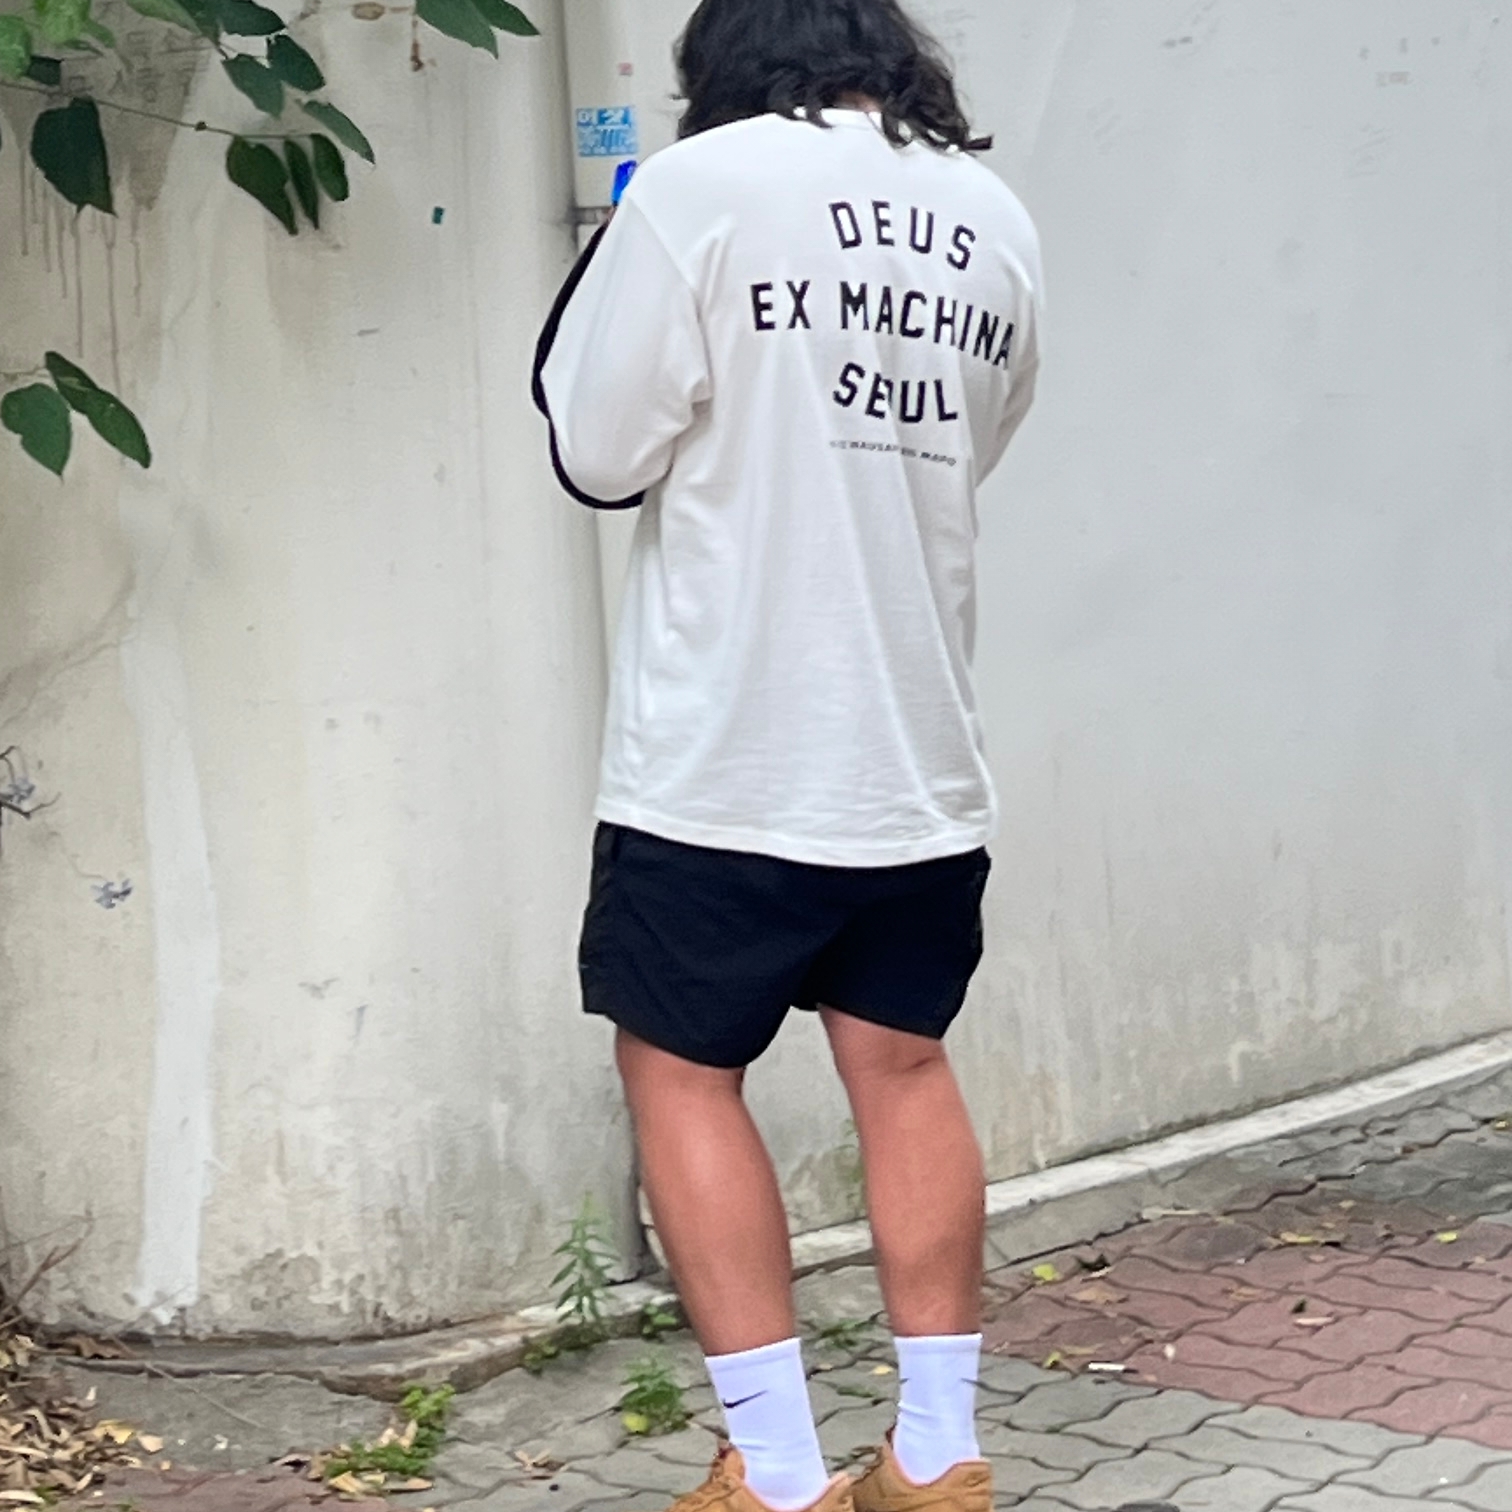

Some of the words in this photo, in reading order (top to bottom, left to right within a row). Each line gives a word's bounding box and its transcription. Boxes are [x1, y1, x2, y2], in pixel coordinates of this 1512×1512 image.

[828, 199, 976, 271] DEUS
[750, 279, 811, 332] EX
[839, 280, 1015, 370] MACHINA
